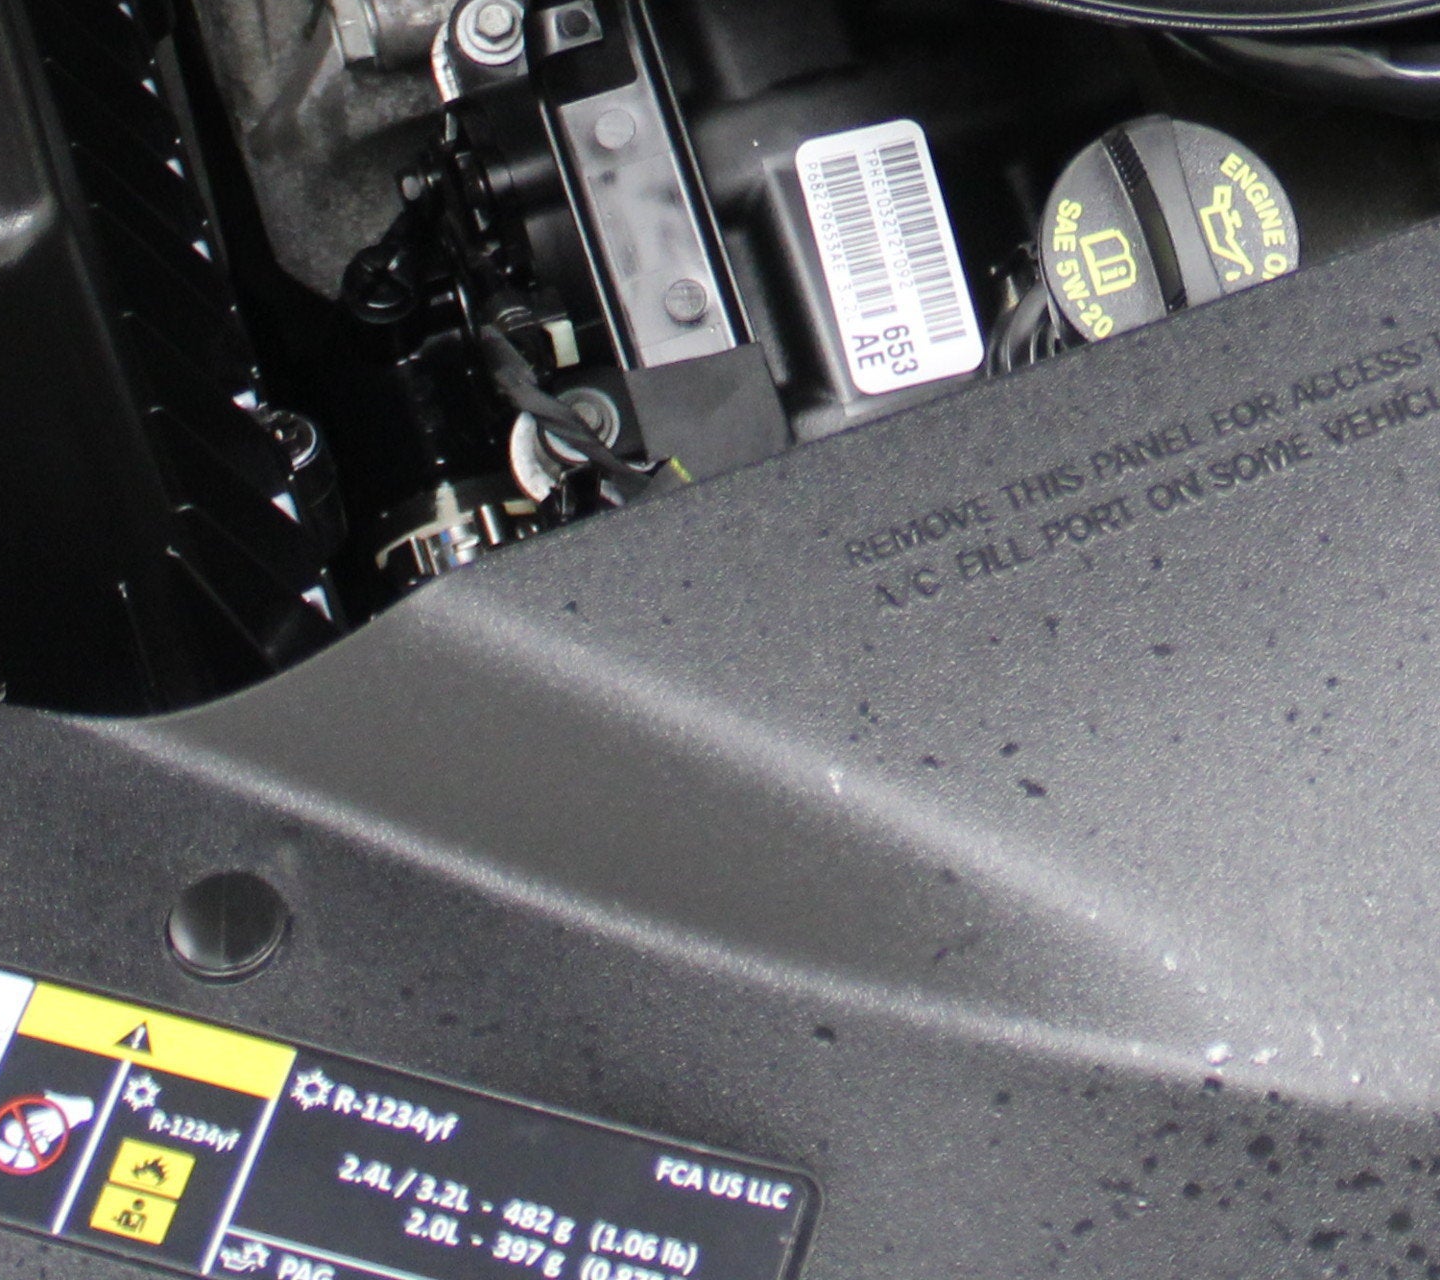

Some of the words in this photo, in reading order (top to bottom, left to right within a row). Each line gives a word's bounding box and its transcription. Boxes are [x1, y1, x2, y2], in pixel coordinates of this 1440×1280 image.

[805, 161, 847, 272] P68229653AE
[1053, 198, 1083, 252] SAE
[1220, 152, 1286, 248] ENGINE
[1261, 252, 1288, 280] O
[1056, 258, 1114, 339] 5W-20
[851, 333, 886, 370] AE
[882, 324, 919, 377] 653
[844, 496, 993, 568] REMOVE
[999, 461, 1085, 516] THIS
[1089, 420, 1201, 486] PANEL
[1209, 394, 1283, 441] FOR
[1290, 340, 1424, 412] ACCESS
[958, 534, 1036, 586] FILL
[1040, 499, 1137, 555] PORT
[1146, 467, 1205, 515] ON
[1211, 431, 1315, 493] SOME
[147, 1108, 242, 1153] R-1234yf
[333, 1083, 460, 1142] R-1234yf
[338, 1151, 393, 1191] 2.4L
[415, 1174, 471, 1213] 3.2L
[502, 1197, 555, 1236] 482
[552, 1215, 577, 1245] g
[590, 1218, 661, 1262] (1.06
[660, 1237, 699, 1276] lb)
[654, 1154, 703, 1191] FCA
[709, 1169, 746, 1200] US
[745, 1178, 793, 1211] LLC
[404, 1206, 461, 1247] 2.0L
[491, 1229, 546, 1268] 397
[542, 1248, 567, 1279] g
